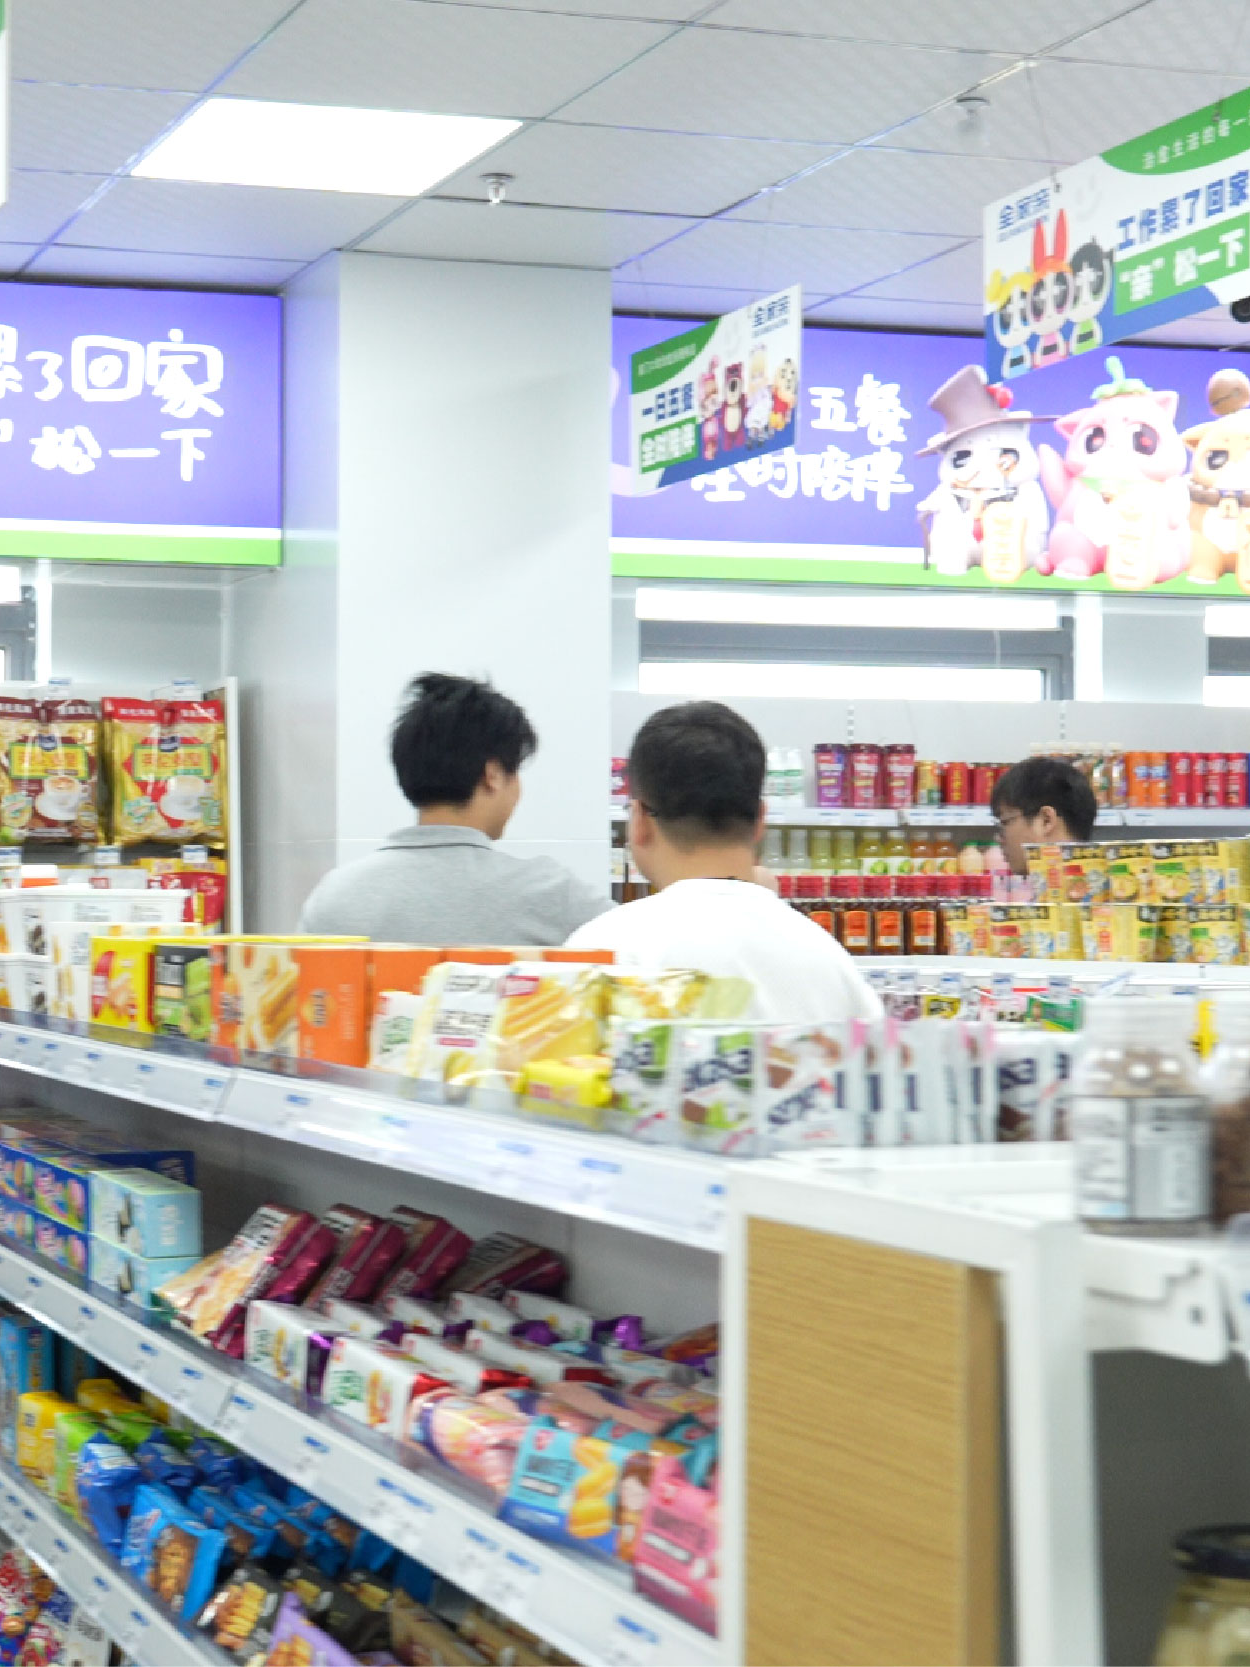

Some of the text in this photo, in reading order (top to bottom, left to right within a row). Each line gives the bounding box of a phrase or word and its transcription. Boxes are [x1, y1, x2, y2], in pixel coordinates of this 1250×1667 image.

[1117, 169, 1250, 252] 工作累了回家
[807, 373, 912, 446] 五餐
